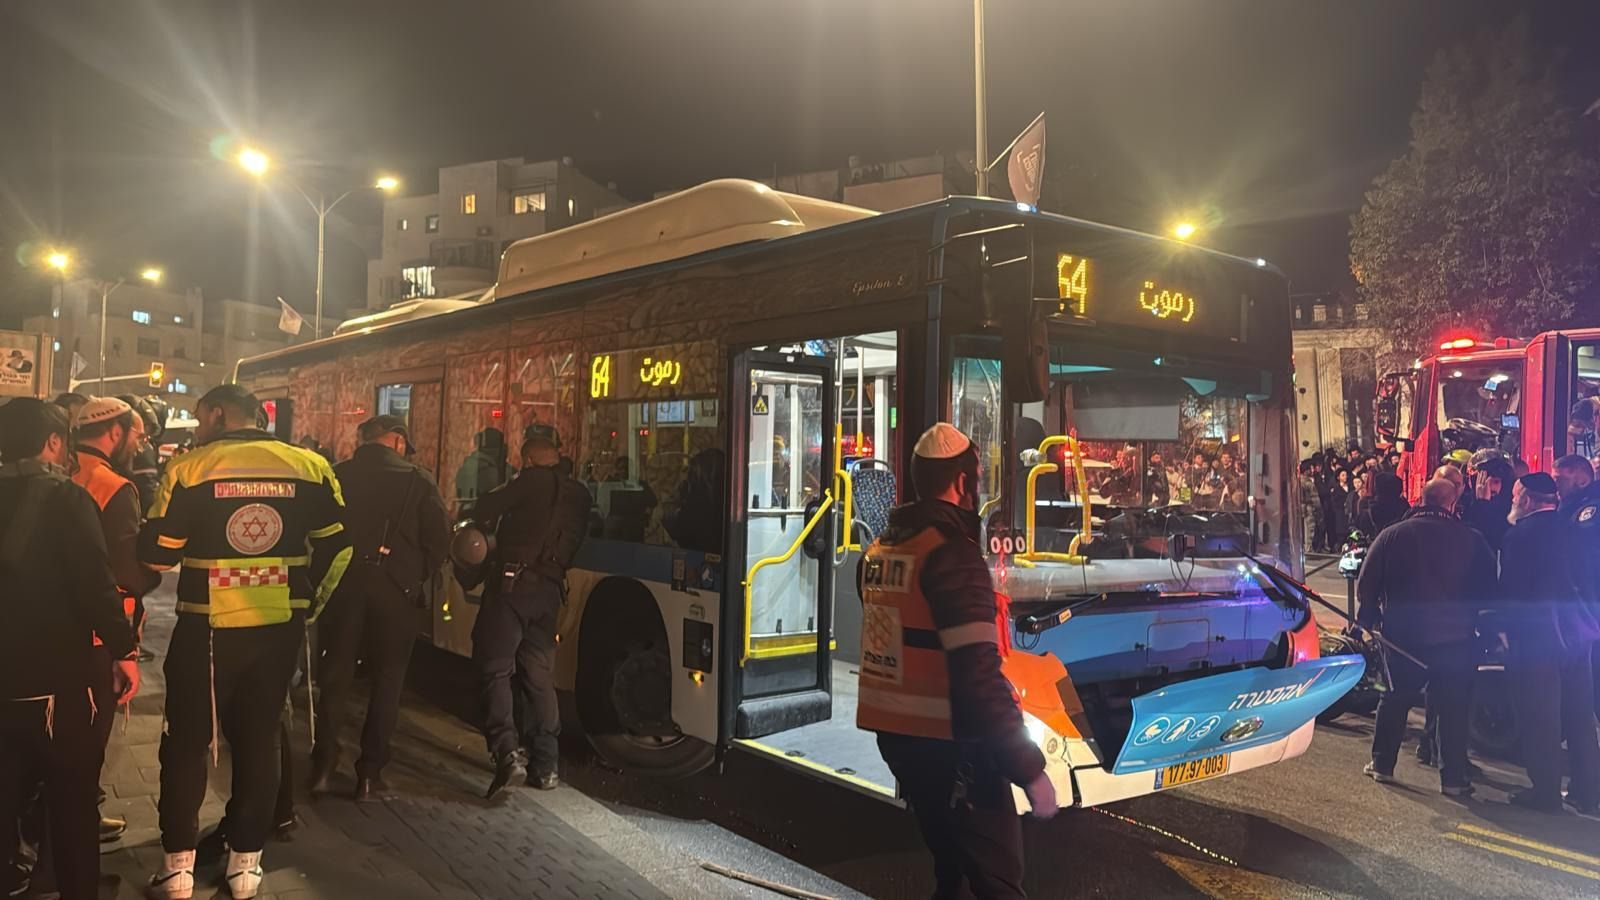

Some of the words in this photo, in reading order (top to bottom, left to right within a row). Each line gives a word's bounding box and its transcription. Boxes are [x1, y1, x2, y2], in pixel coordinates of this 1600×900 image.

[1057, 255, 1087, 314] 64
[1139, 281, 1194, 322] رموت
[591, 355, 610, 398] 64
[640, 357, 681, 386] رموت
